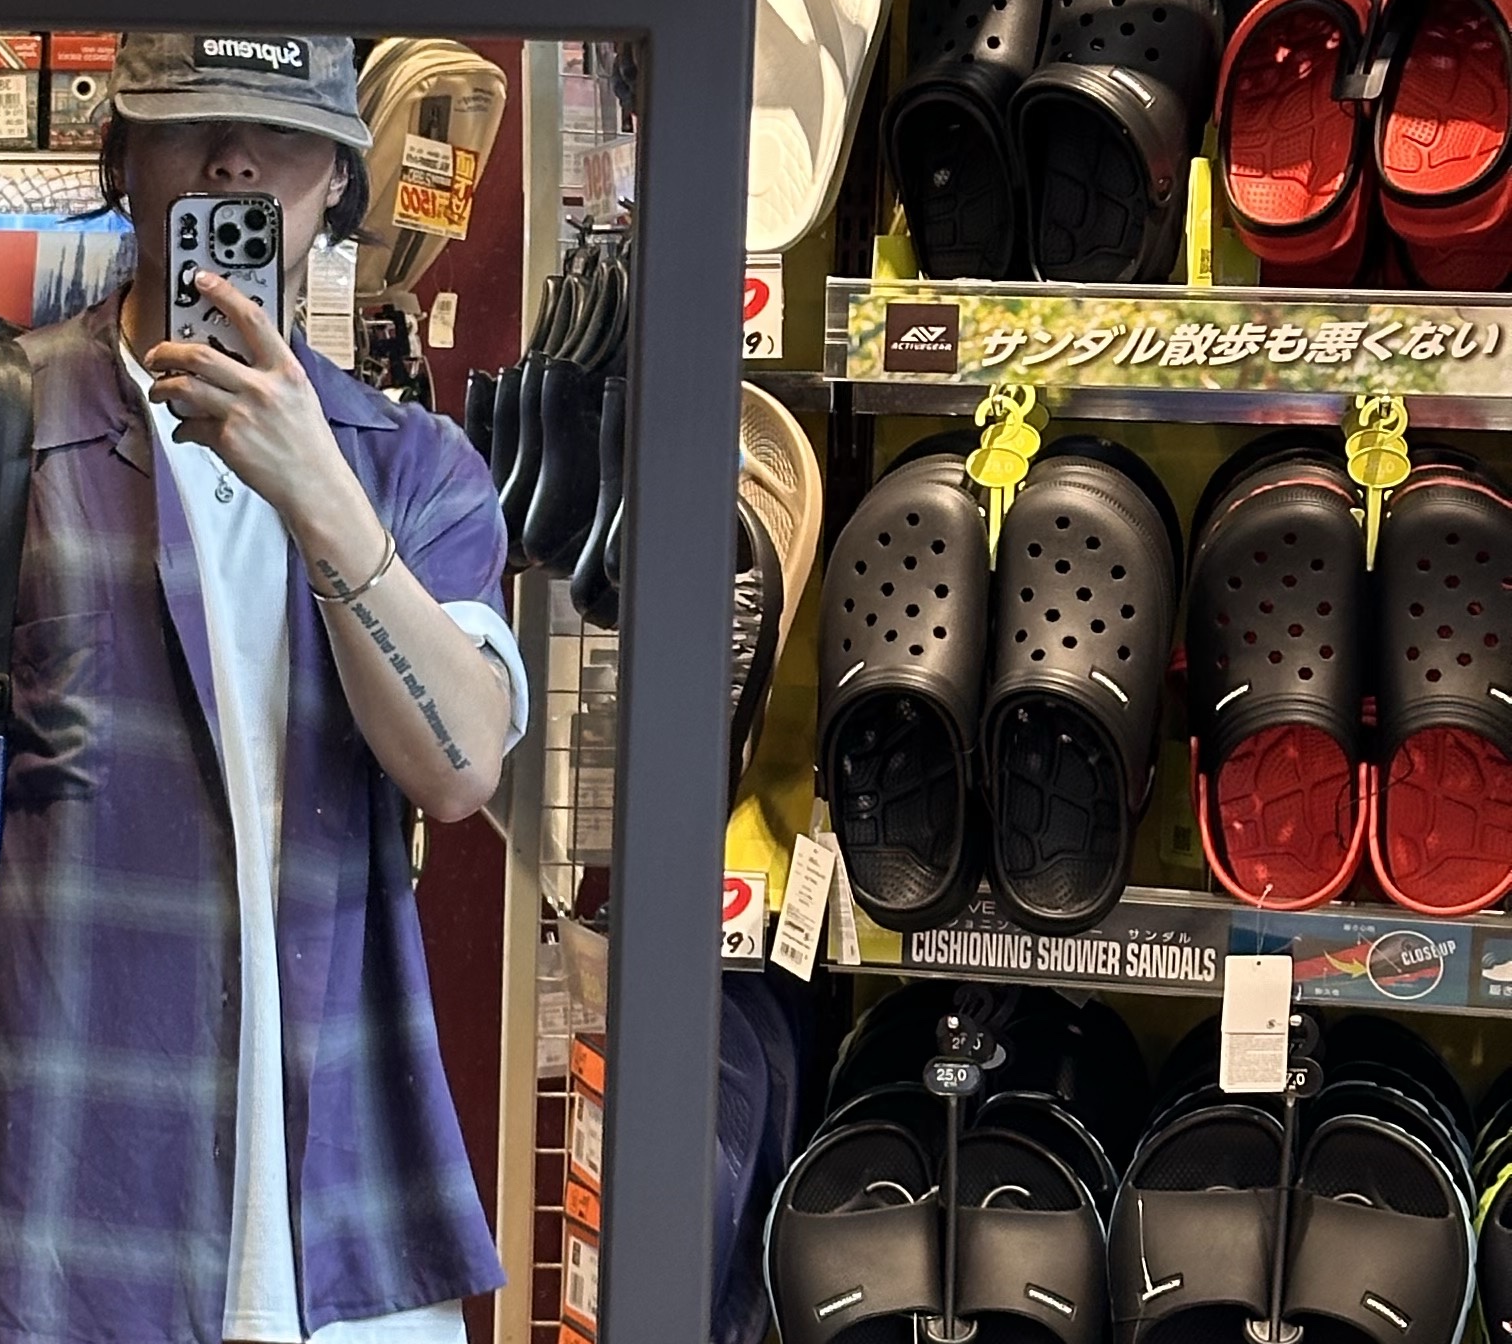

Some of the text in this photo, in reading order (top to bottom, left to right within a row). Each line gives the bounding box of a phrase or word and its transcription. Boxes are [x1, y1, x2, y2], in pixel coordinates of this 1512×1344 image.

[981, 321, 1499, 368] サンダル散歩も悪くない
[911, 929, 1217, 982] CUSHIONING SHOWER SANDALS
[1400, 939, 1457, 966] CLOSE UP
